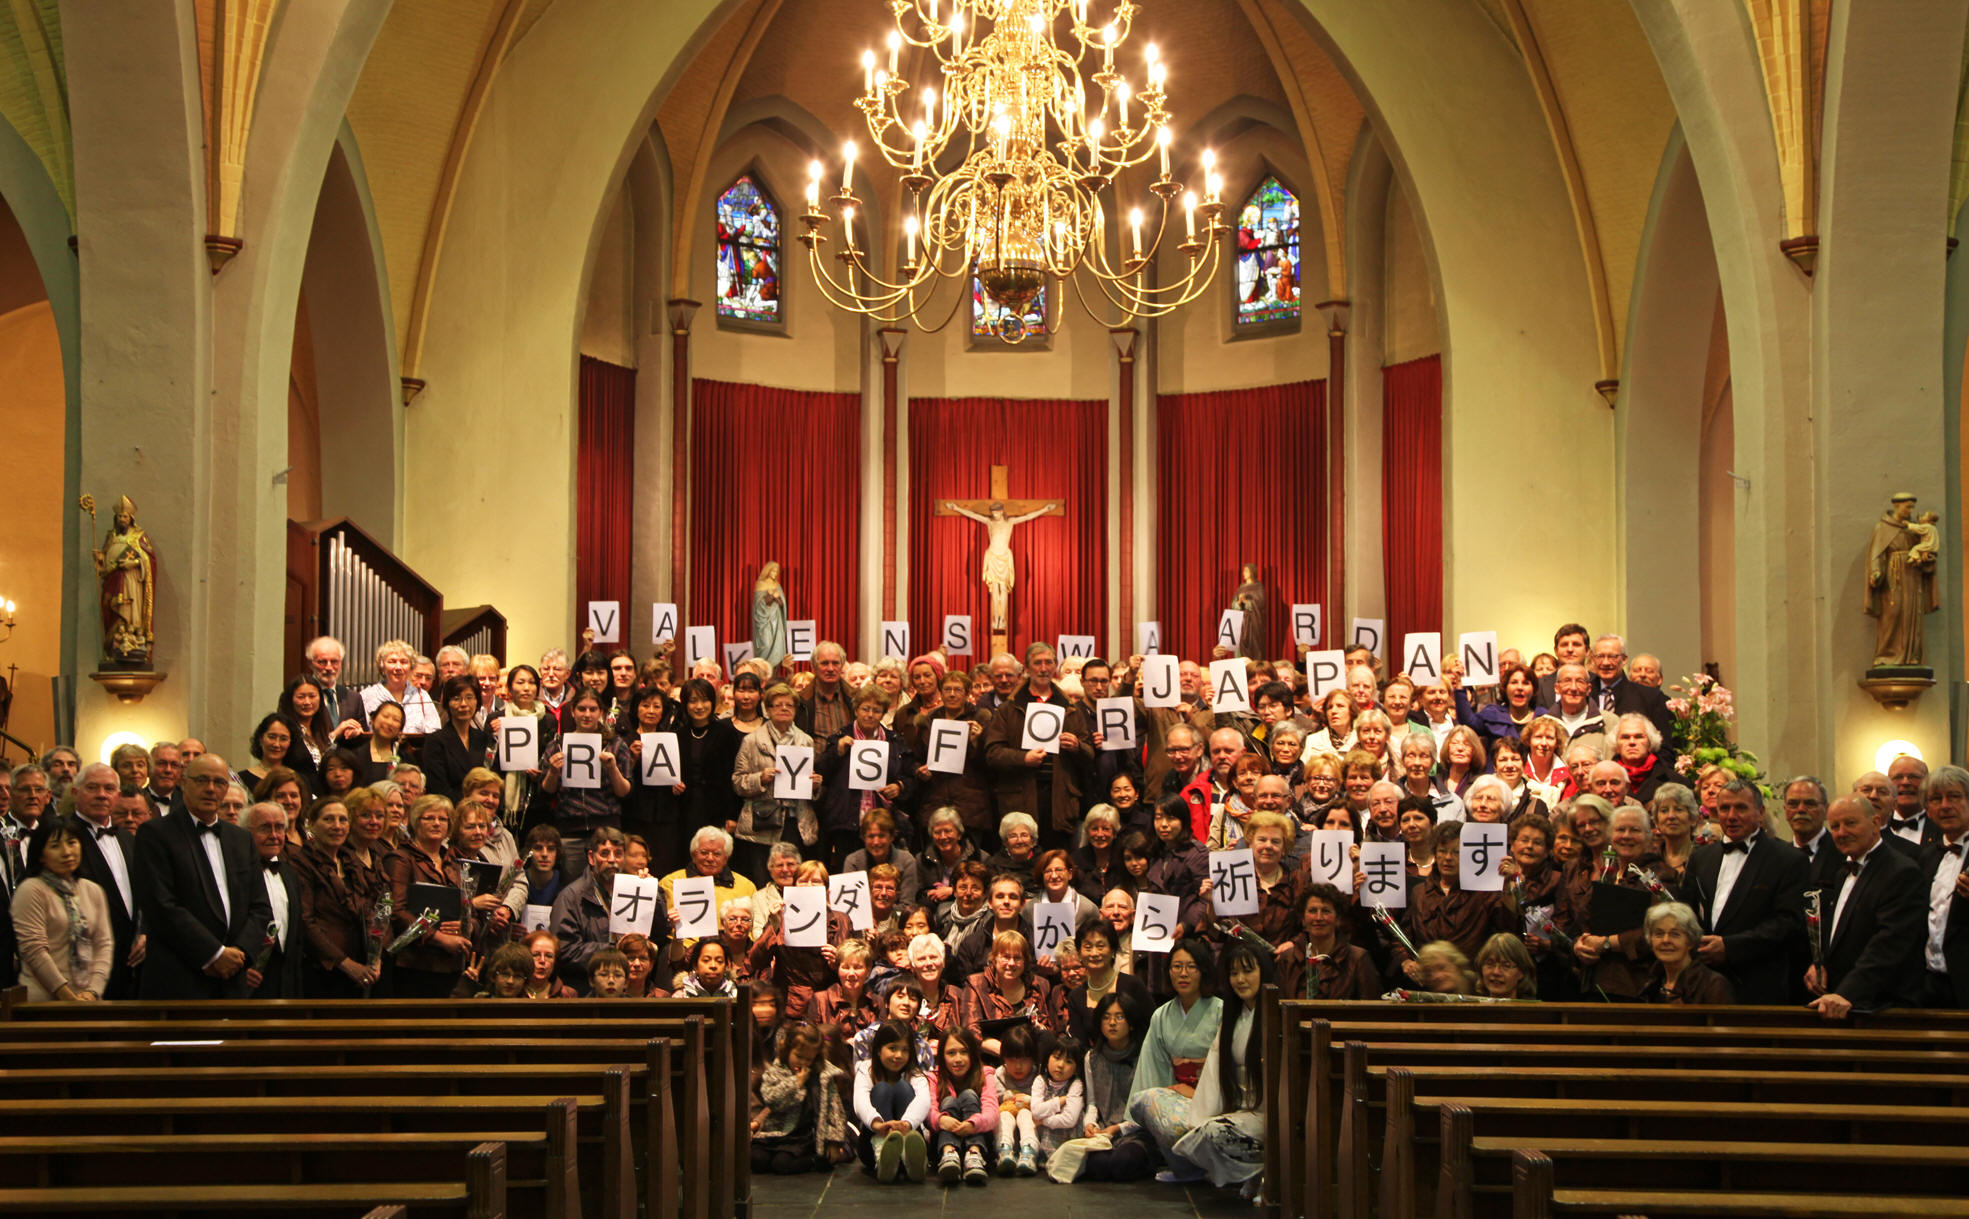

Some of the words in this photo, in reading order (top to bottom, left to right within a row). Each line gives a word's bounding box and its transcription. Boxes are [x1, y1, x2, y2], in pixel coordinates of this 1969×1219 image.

[593, 610, 615, 636] V
[656, 612, 676, 638] A
[692, 635, 701, 660] L
[791, 628, 810, 654] E
[885, 630, 906, 655] N
[948, 623, 967, 649] S
[1219, 618, 1236, 645] A
[1295, 613, 1316, 639] R
[1355, 627, 1378, 651] D
[505, 728, 531, 762] P
[566, 744, 595, 779] R
[646, 743, 677, 777] A
[781, 756, 809, 790] Y
[856, 749, 882, 781] S
[934, 729, 961, 762] F
[1027, 710, 1060, 742] O
[1102, 708, 1130, 741] R
[1152, 665, 1171, 698] J
[1217, 670, 1244, 704] A
[1314, 662, 1339, 695] P
[1407, 644, 1436, 678] A
[1464, 642, 1493, 677] N
[1212, 860, 1253, 903] 祈
[1321, 842, 1342, 880] り
[1364, 854, 1400, 894] ま
[1463, 833, 1503, 876] す
[615, 886, 653, 922] オ
[680, 891, 709, 925] ラ
[789, 904, 820, 933] ン
[834, 881, 864, 914] ダ
[1037, 916, 1071, 949] か
[1141, 906, 1167, 940] ら
